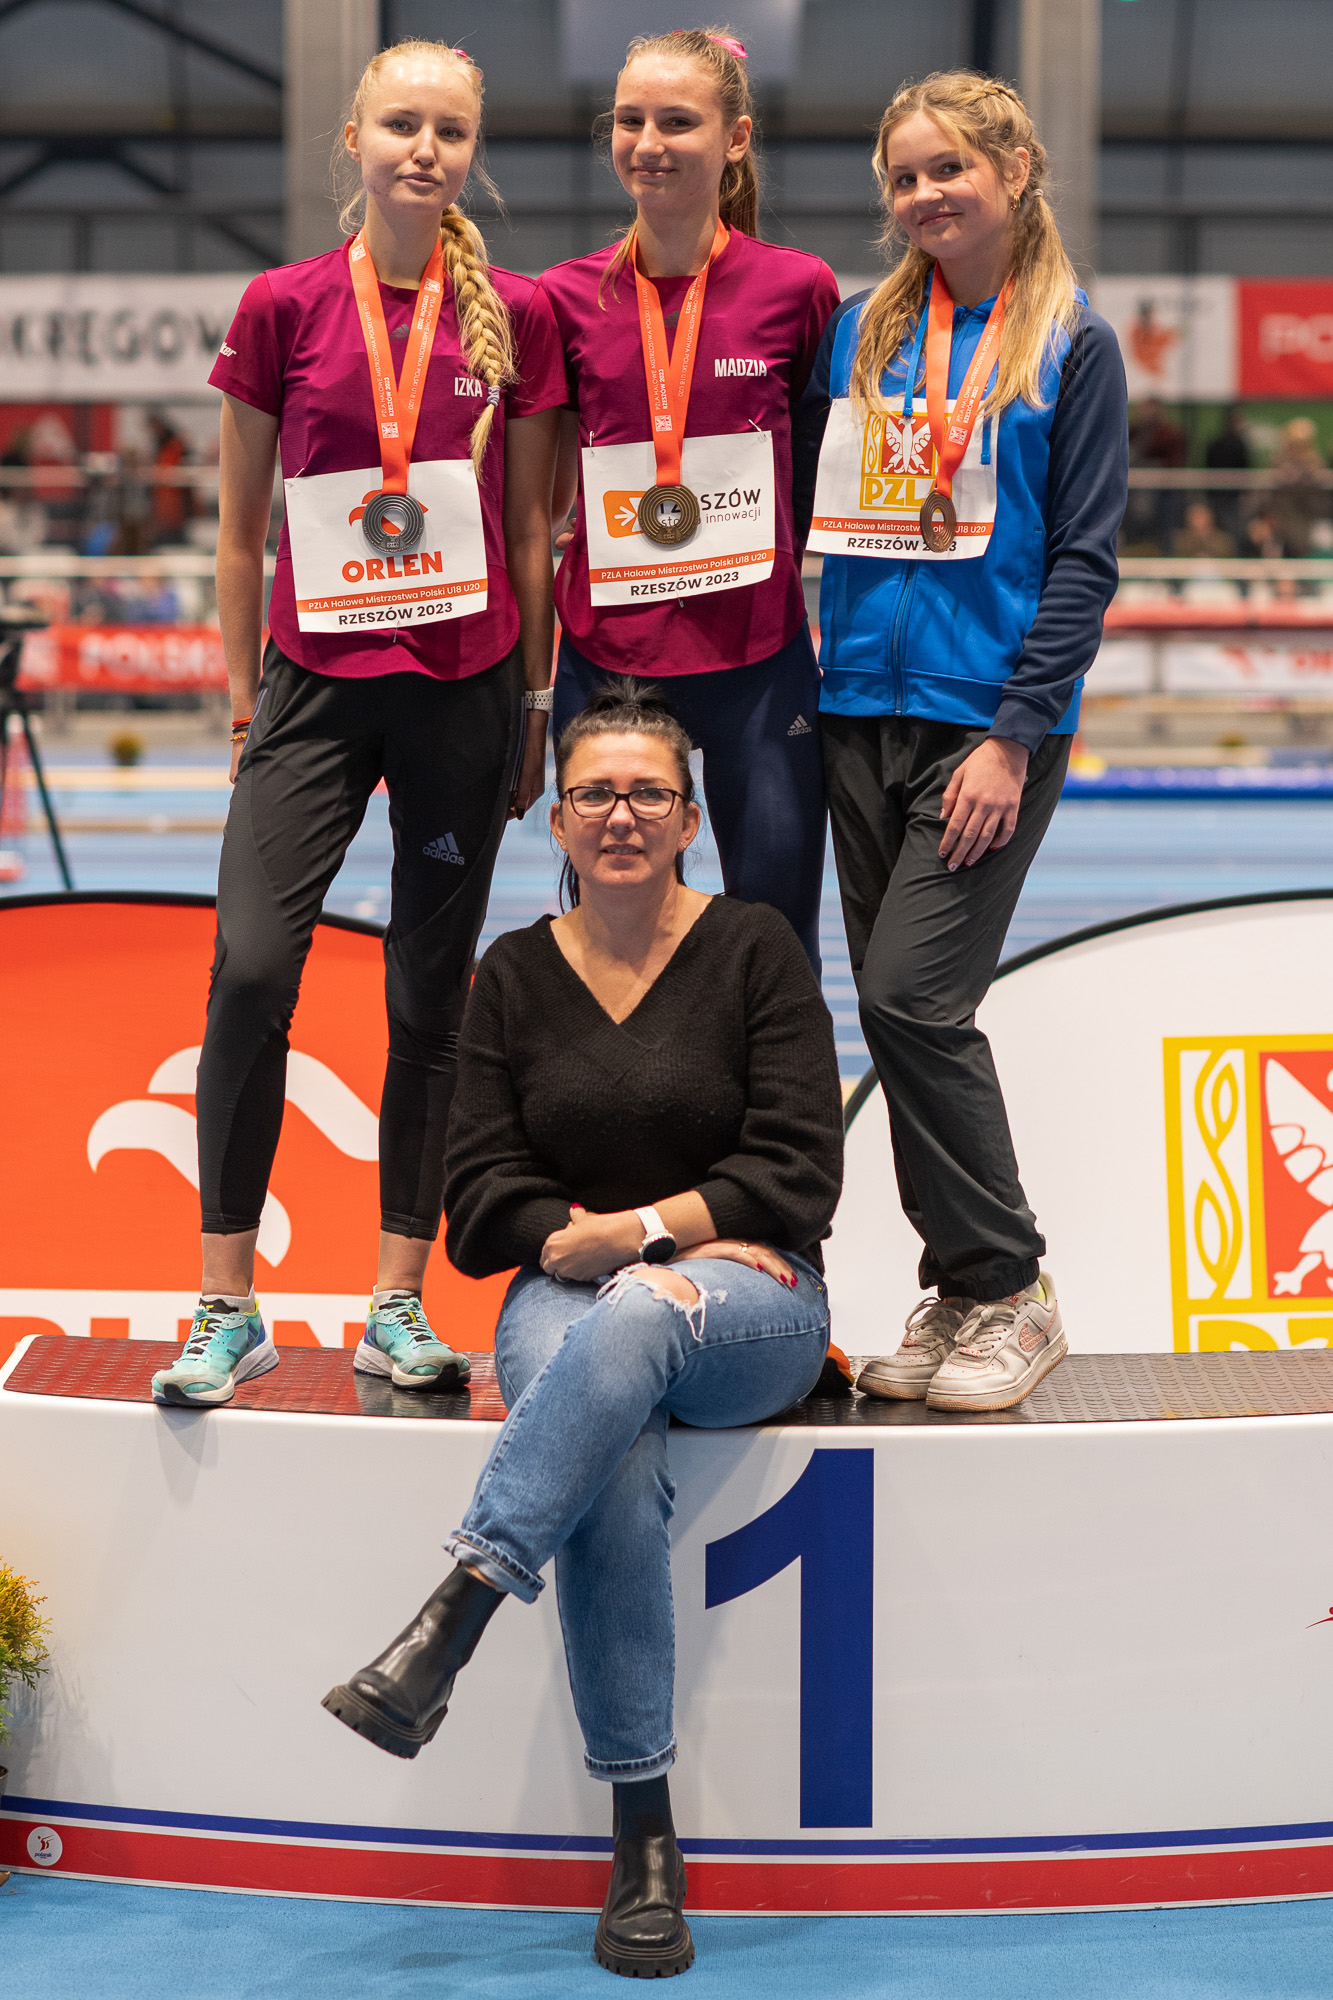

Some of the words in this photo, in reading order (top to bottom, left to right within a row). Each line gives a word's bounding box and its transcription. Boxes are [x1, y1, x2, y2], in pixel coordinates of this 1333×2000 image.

[420, 294, 430, 318] RZESZÓW
[368, 321, 376, 340] POLSKI
[424, 309, 434, 332] HALOWE
[685, 314, 696, 352] MISTRZOSTWA
[371, 340, 382, 378] MISTRZOSTWA
[416, 331, 428, 368] MISTRZOSTWA
[646, 330, 656, 369] MISTRZOSTWA
[682, 354, 690, 375] POLSKI
[714, 358, 768, 378] MADZIA
[960, 386, 972, 409] HALOWE
[968, 351, 986, 385] MISTRZOSTWA
[982, 334, 992, 352] POLSKI
[384, 377, 392, 390] 2023
[412, 368, 422, 387] POLSKI
[454, 377, 482, 398] IZKA
[376, 378, 384, 403] HALOWE
[660, 384, 668, 410] RZESZÓW
[386, 391, 394, 416] RZESZÓW
[962, 398, 974, 424] RZESZÓW
[971, 386, 980, 398] 2023
[865, 477, 936, 507] PZL
[706, 507, 762, 524] innowacji
[822, 520, 843, 529] PZLA
[844, 521, 876, 531] Halowe
[877, 522, 921, 532] Mistrzostw
[970, 526, 986, 534] U20
[847, 536, 920, 550] RZESZÓW
[342, 550, 444, 583] ORLEN
[602, 572, 622, 580] PZLA
[624, 568, 656, 578] Halowe
[658, 562, 709, 575] Mistrzostwa
[710, 558, 734, 569] Polski
[735, 556, 750, 564] U18
[751, 552, 767, 562] U20
[308, 600, 330, 610] PZLA
[331, 598, 364, 608] Halowe
[366, 591, 420, 604] Mistrzostwa
[420, 589, 446, 600] Polski
[447, 586, 462, 595] U18
[464, 582, 480, 593] U20
[630, 577, 703, 596] RZESZÓW
[706, 571, 740, 587] 2023
[338, 606, 414, 626] RZESZÓW
[416, 602, 453, 620] 2023
[788, 726, 812, 736] adidas
[422, 846, 465, 866] adidas
[705, 1448, 874, 1829] 1
